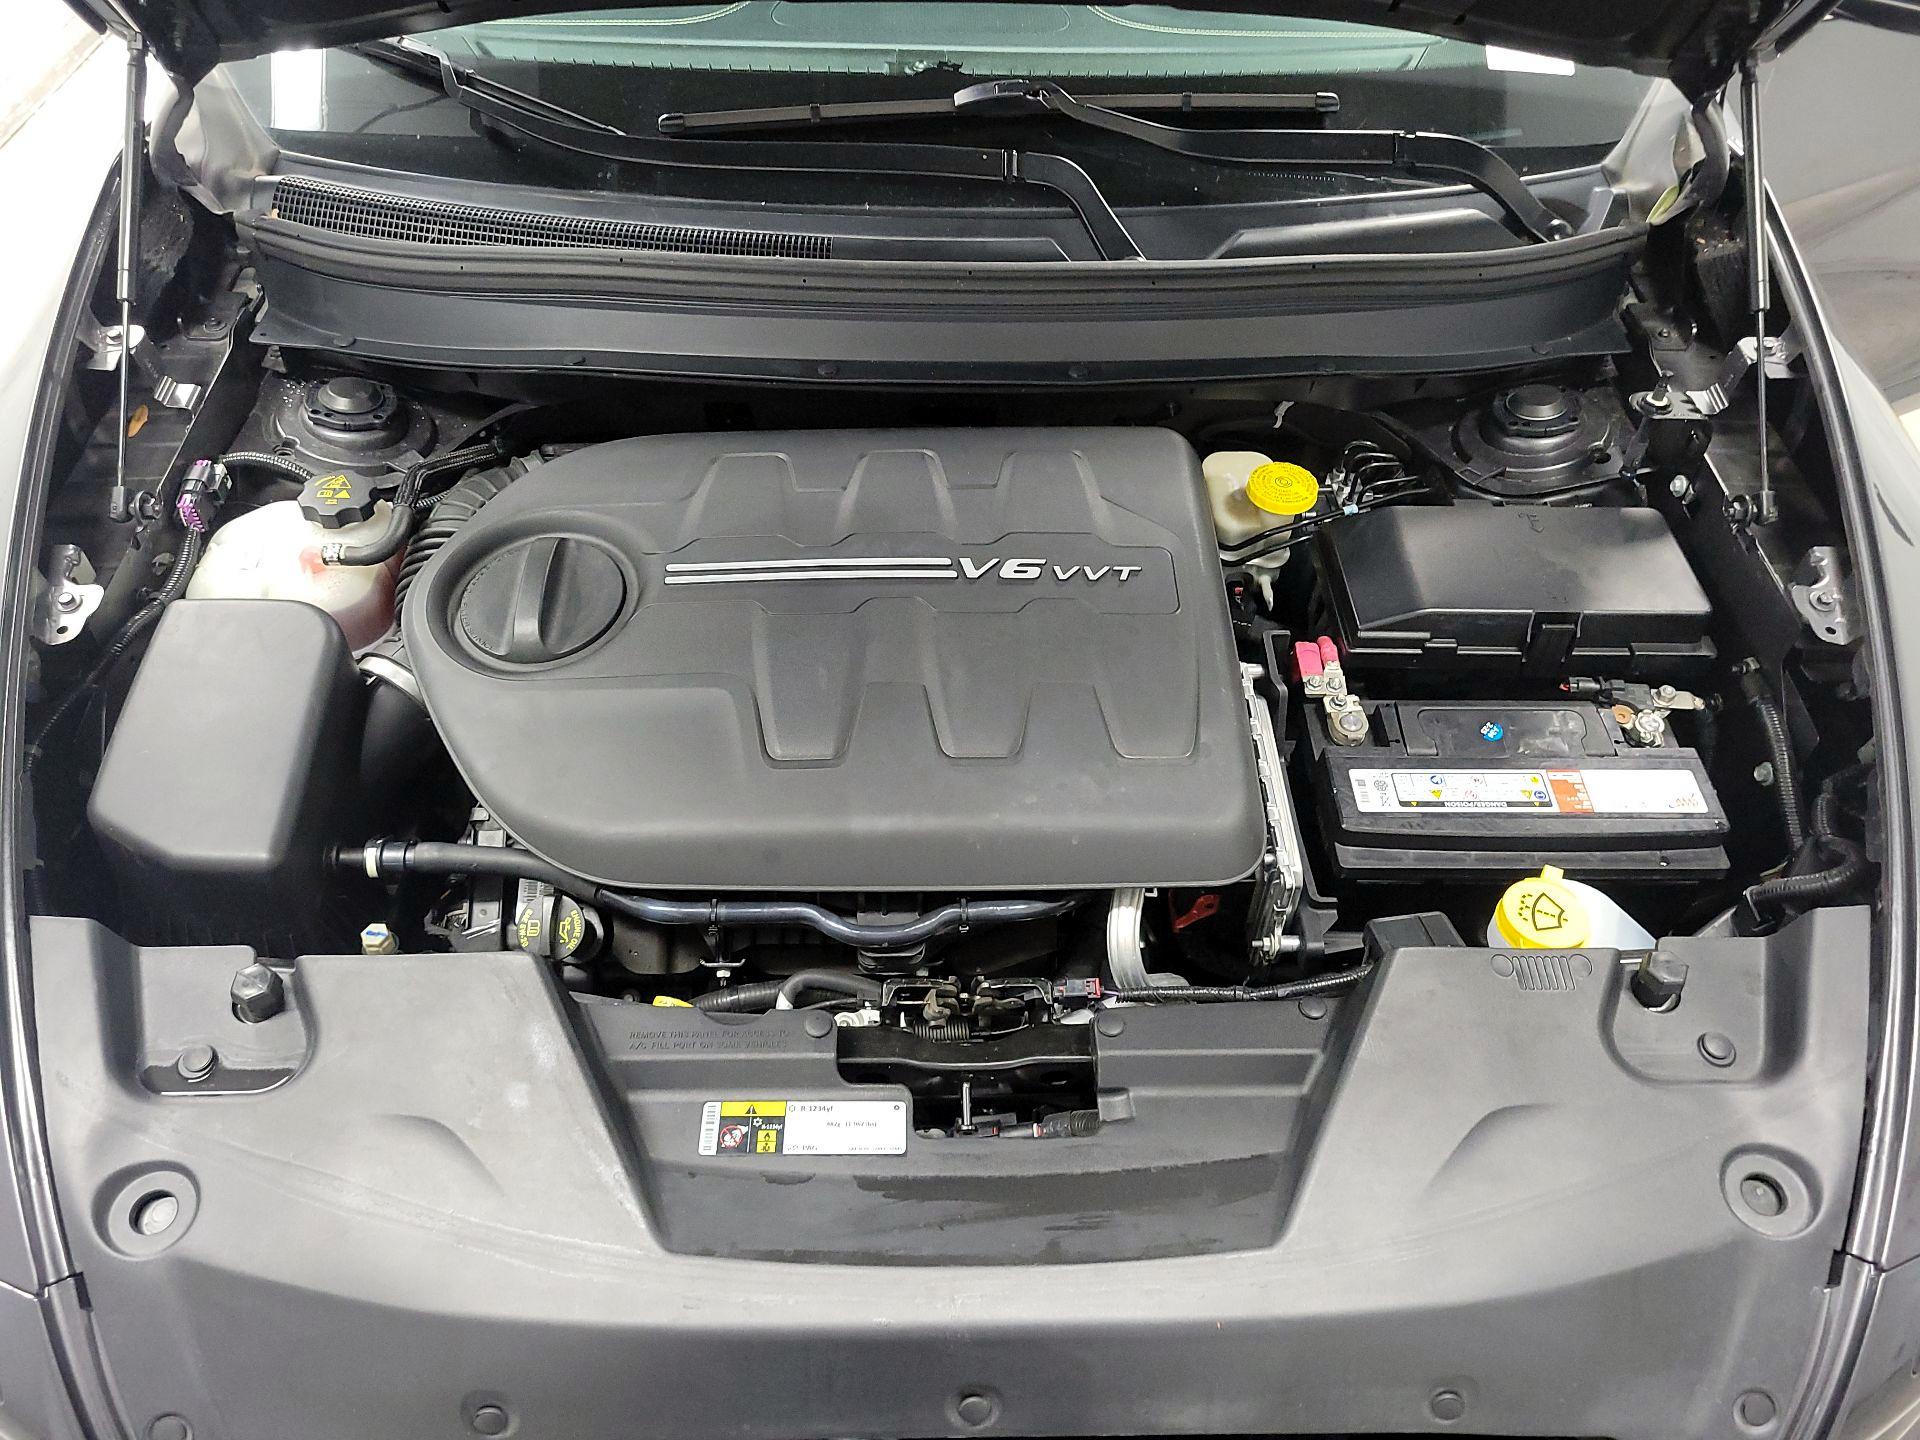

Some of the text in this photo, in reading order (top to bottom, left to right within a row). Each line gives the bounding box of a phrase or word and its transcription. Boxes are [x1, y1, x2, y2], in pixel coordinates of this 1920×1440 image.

[958, 556, 1142, 582] V6 VVT
[565, 909, 583, 951] ENGINE OIL
[629, 1031, 667, 1039] REMOVE
[670, 1031, 689, 1039] THIS
[721, 1030, 739, 1038] FOR
[778, 1029, 790, 1038] TO
[650, 1041, 670, 1050] FILL
[673, 1041, 696, 1050] PORT
[699, 1041, 714, 1049] ON
